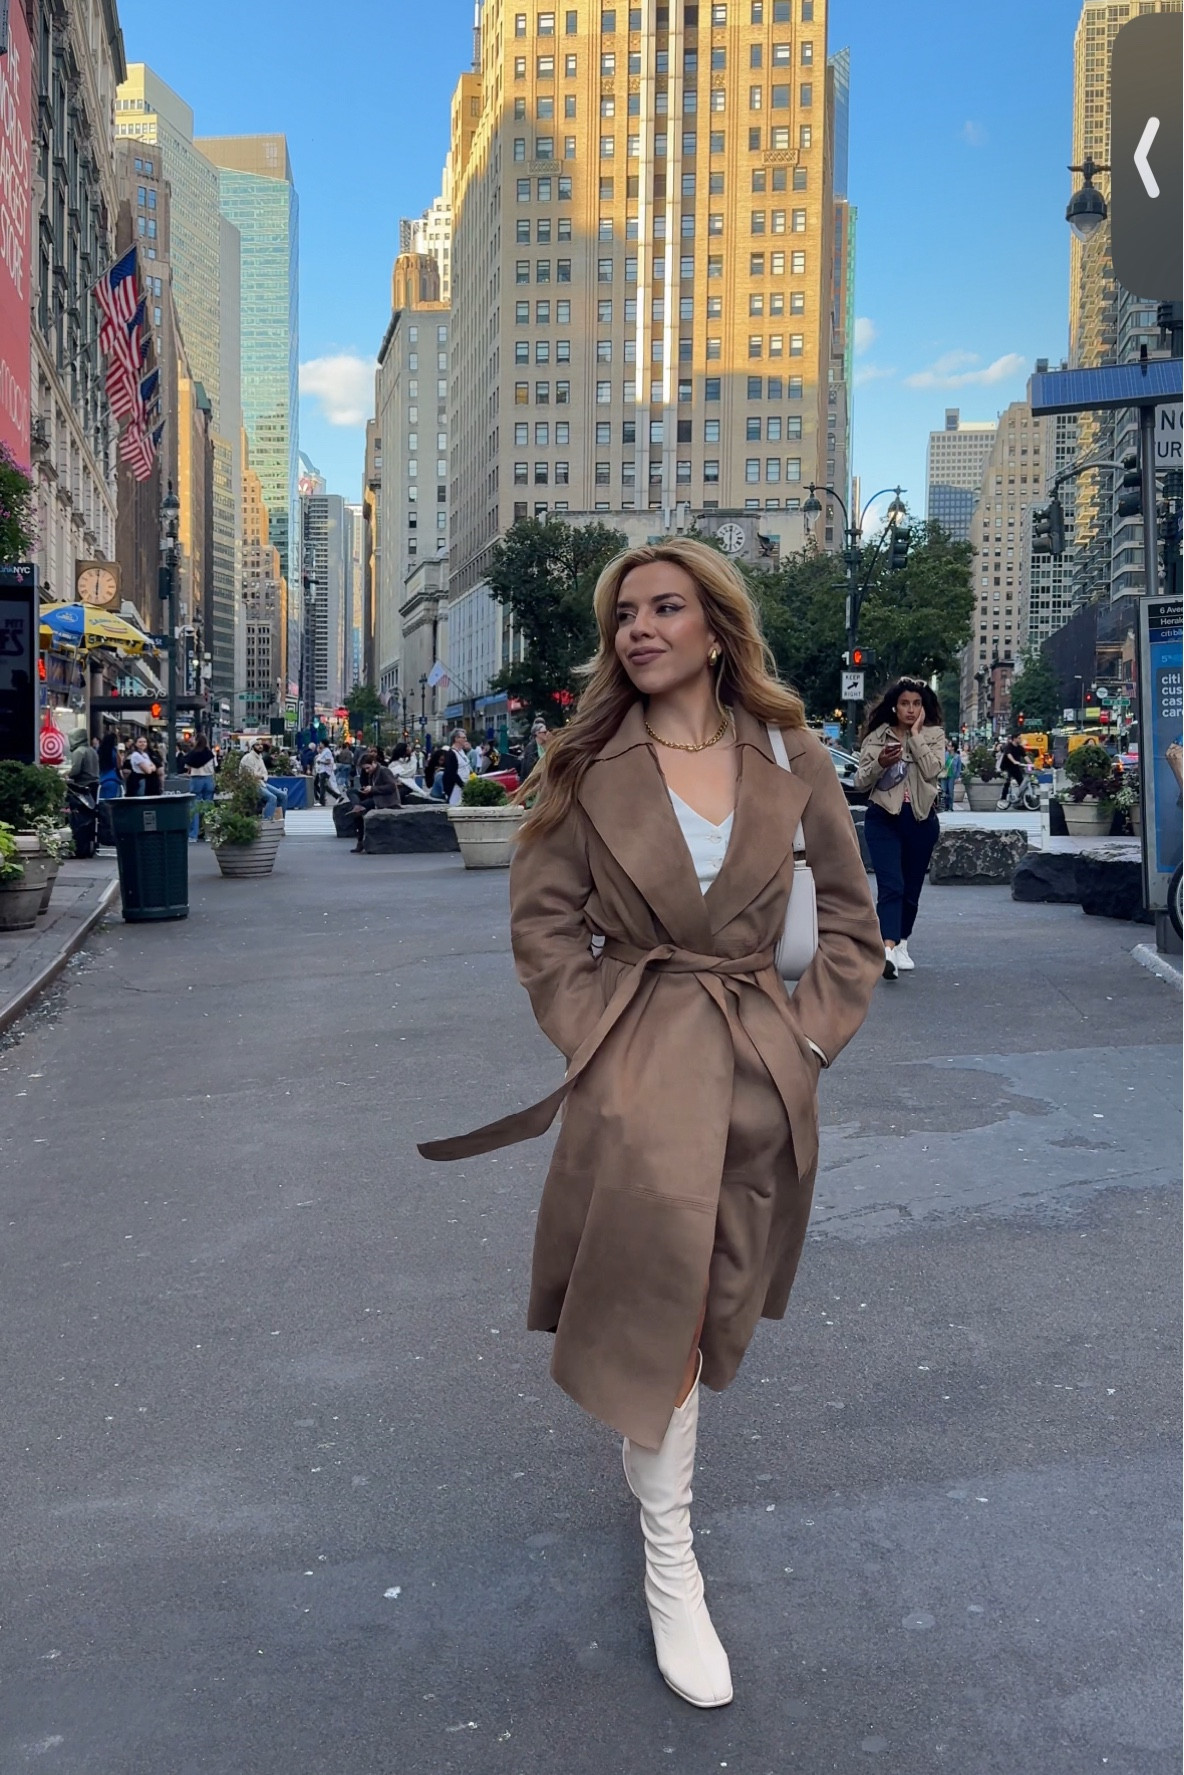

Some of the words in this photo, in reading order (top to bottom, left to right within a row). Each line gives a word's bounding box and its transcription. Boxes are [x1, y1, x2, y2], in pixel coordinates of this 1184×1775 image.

[8, 24, 20, 106] THE
[1, 204, 24, 301] STORE
[1161, 410, 1183, 430] N
[1160, 607, 1165, 615] 6
[1161, 673, 1181, 685] citi
